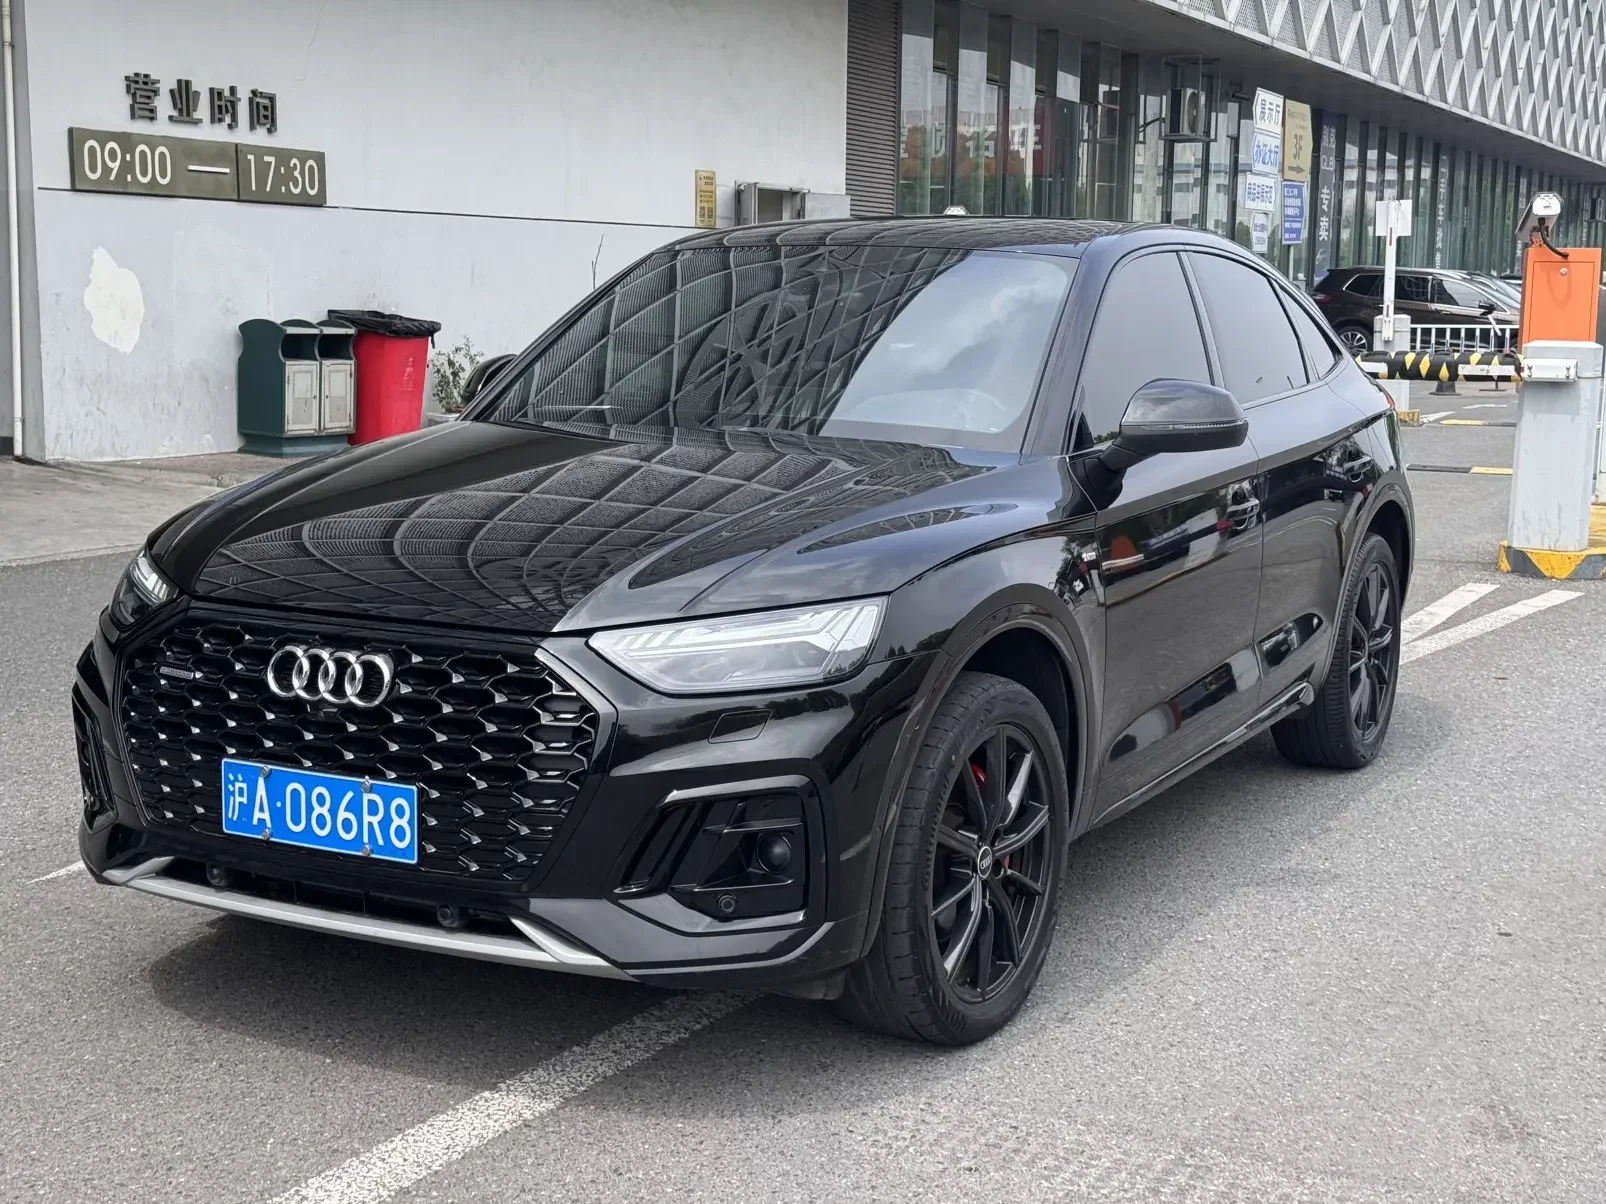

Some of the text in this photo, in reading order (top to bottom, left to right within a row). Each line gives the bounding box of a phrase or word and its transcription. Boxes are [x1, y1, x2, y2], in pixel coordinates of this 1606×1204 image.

[124, 72, 277, 133] 营业时间
[1259, 98, 1281, 127] 展示厅
[1254, 140, 1280, 168] 办证大厅
[1293, 133, 1303, 160] 3F
[83, 139, 172, 185] 09:00
[247, 153, 319, 196] 17:30
